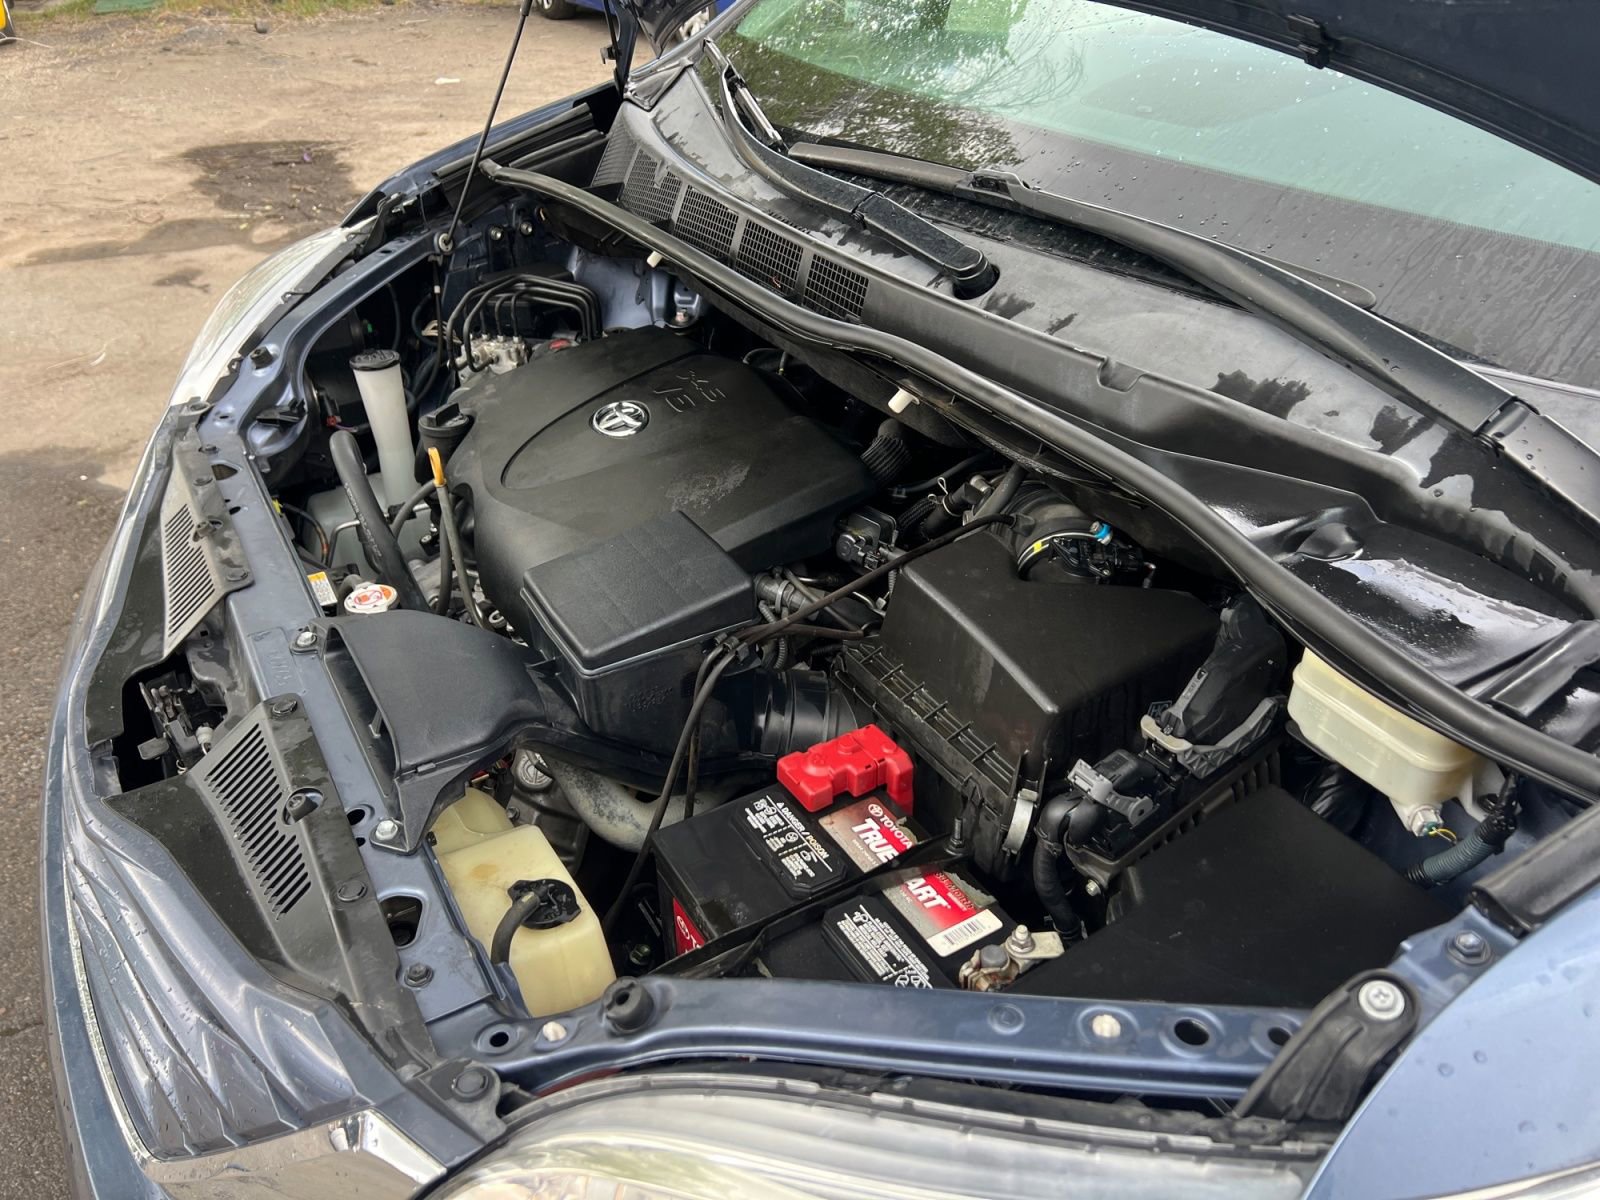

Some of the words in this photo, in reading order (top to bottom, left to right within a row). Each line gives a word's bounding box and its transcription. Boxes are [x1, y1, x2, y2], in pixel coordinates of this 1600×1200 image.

[781, 806, 806, 832] DANGER
[806, 834, 830, 859] POISON
[880, 814, 913, 850] TOYOTA
[851, 817, 900, 863] TRUE
[904, 877, 948, 909] ART
